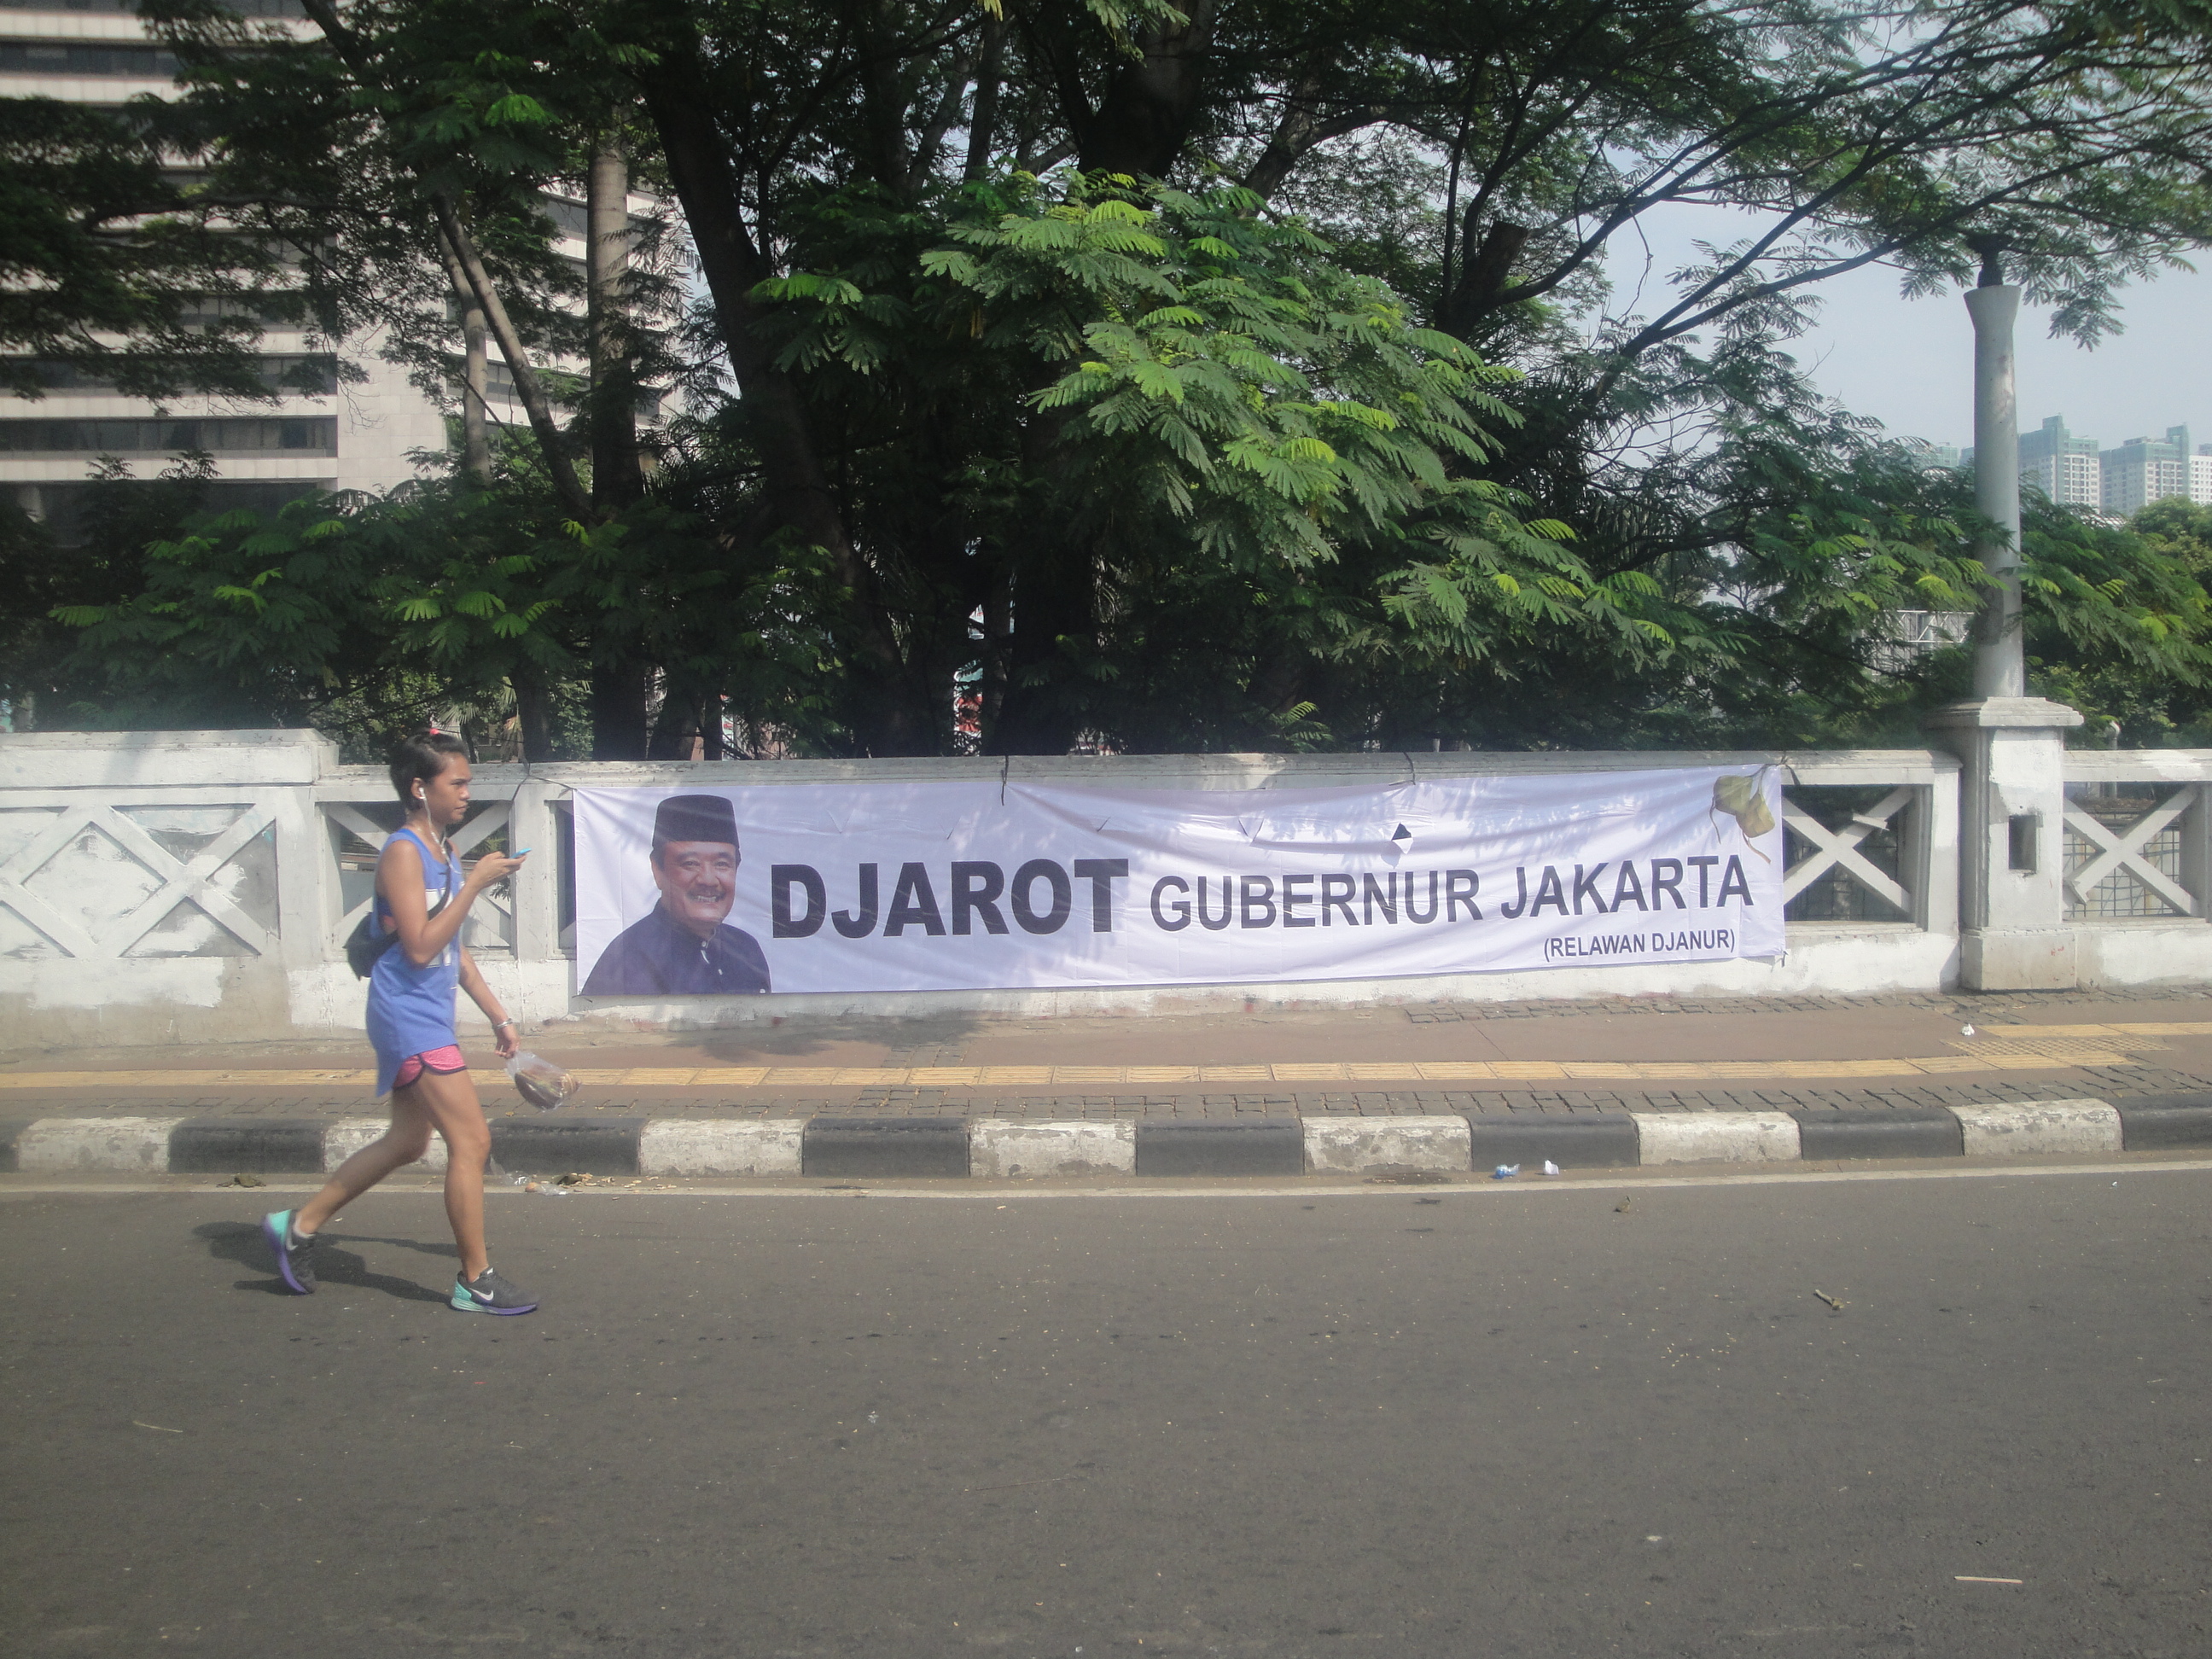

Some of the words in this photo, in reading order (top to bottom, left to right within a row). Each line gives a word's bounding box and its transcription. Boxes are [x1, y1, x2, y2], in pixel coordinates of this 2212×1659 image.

[771, 858, 1128, 939] DJAROT
[1150, 868, 1483, 932] GUBERNUR
[1500, 854, 1753, 920] JAKARTA
[1544, 932, 1646, 963] (RELAWAN
[1652, 928, 1736, 955] DJANUR)
